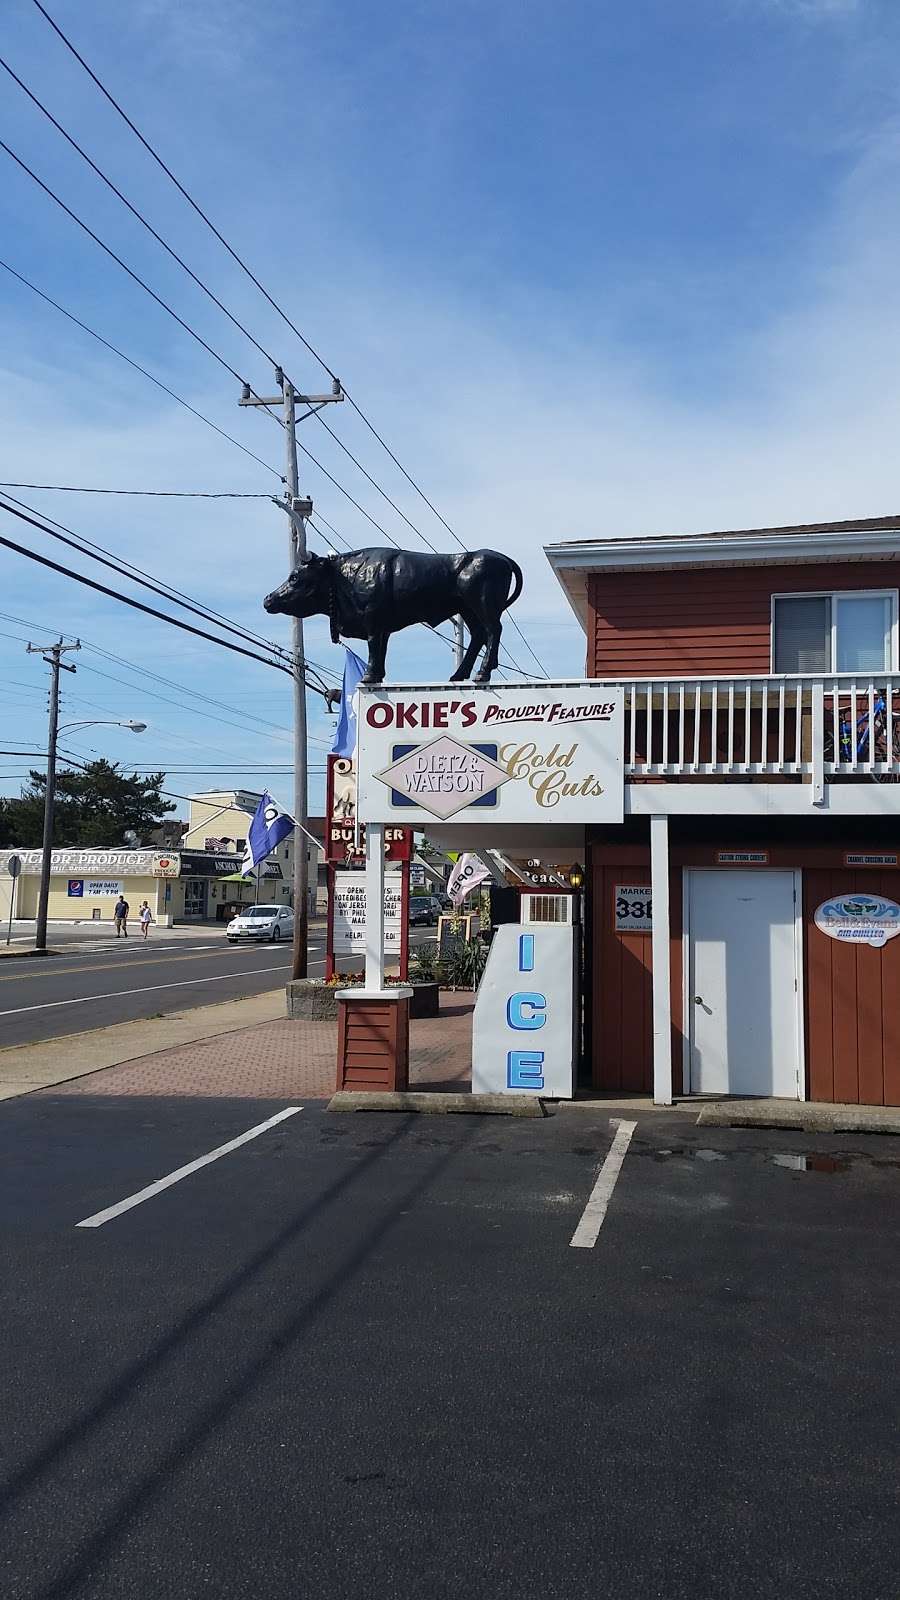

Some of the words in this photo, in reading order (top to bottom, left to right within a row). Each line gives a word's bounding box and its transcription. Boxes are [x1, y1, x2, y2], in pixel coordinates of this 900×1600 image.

[366, 701, 478, 729] OKIE'S
[547, 702, 616, 722] FEATURES
[415, 755, 468, 774] DIETZ
[499, 742, 579, 780] Cold
[405, 773, 485, 793] WATSON
[528, 769, 604, 808] Cuts
[77, 855, 146, 865] PRODUCE
[507, 934, 547, 1089] ICE
